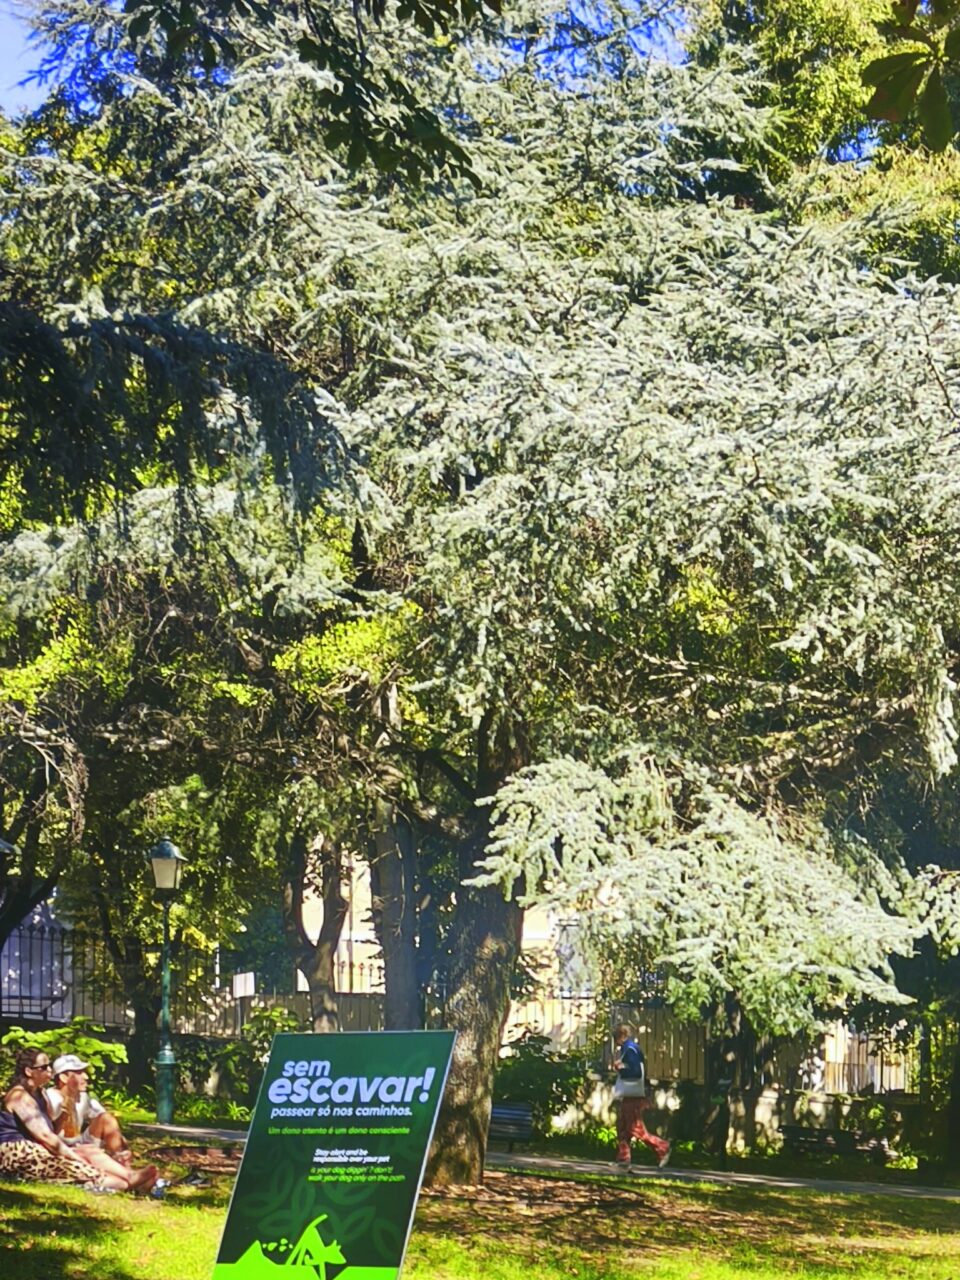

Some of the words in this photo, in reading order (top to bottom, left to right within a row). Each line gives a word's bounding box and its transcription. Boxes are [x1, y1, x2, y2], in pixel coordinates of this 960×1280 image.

[282, 1060, 331, 1077] sem
[268, 1067, 436, 1104] escavar!
[270, 1106, 316, 1119] passear
[317, 1104, 331, 1117] só
[332, 1106, 353, 1117] nos
[355, 1104, 413, 1117] caminhos.
[331, 1167, 346, 1175] dog
[338, 1174, 353, 1183] dog
